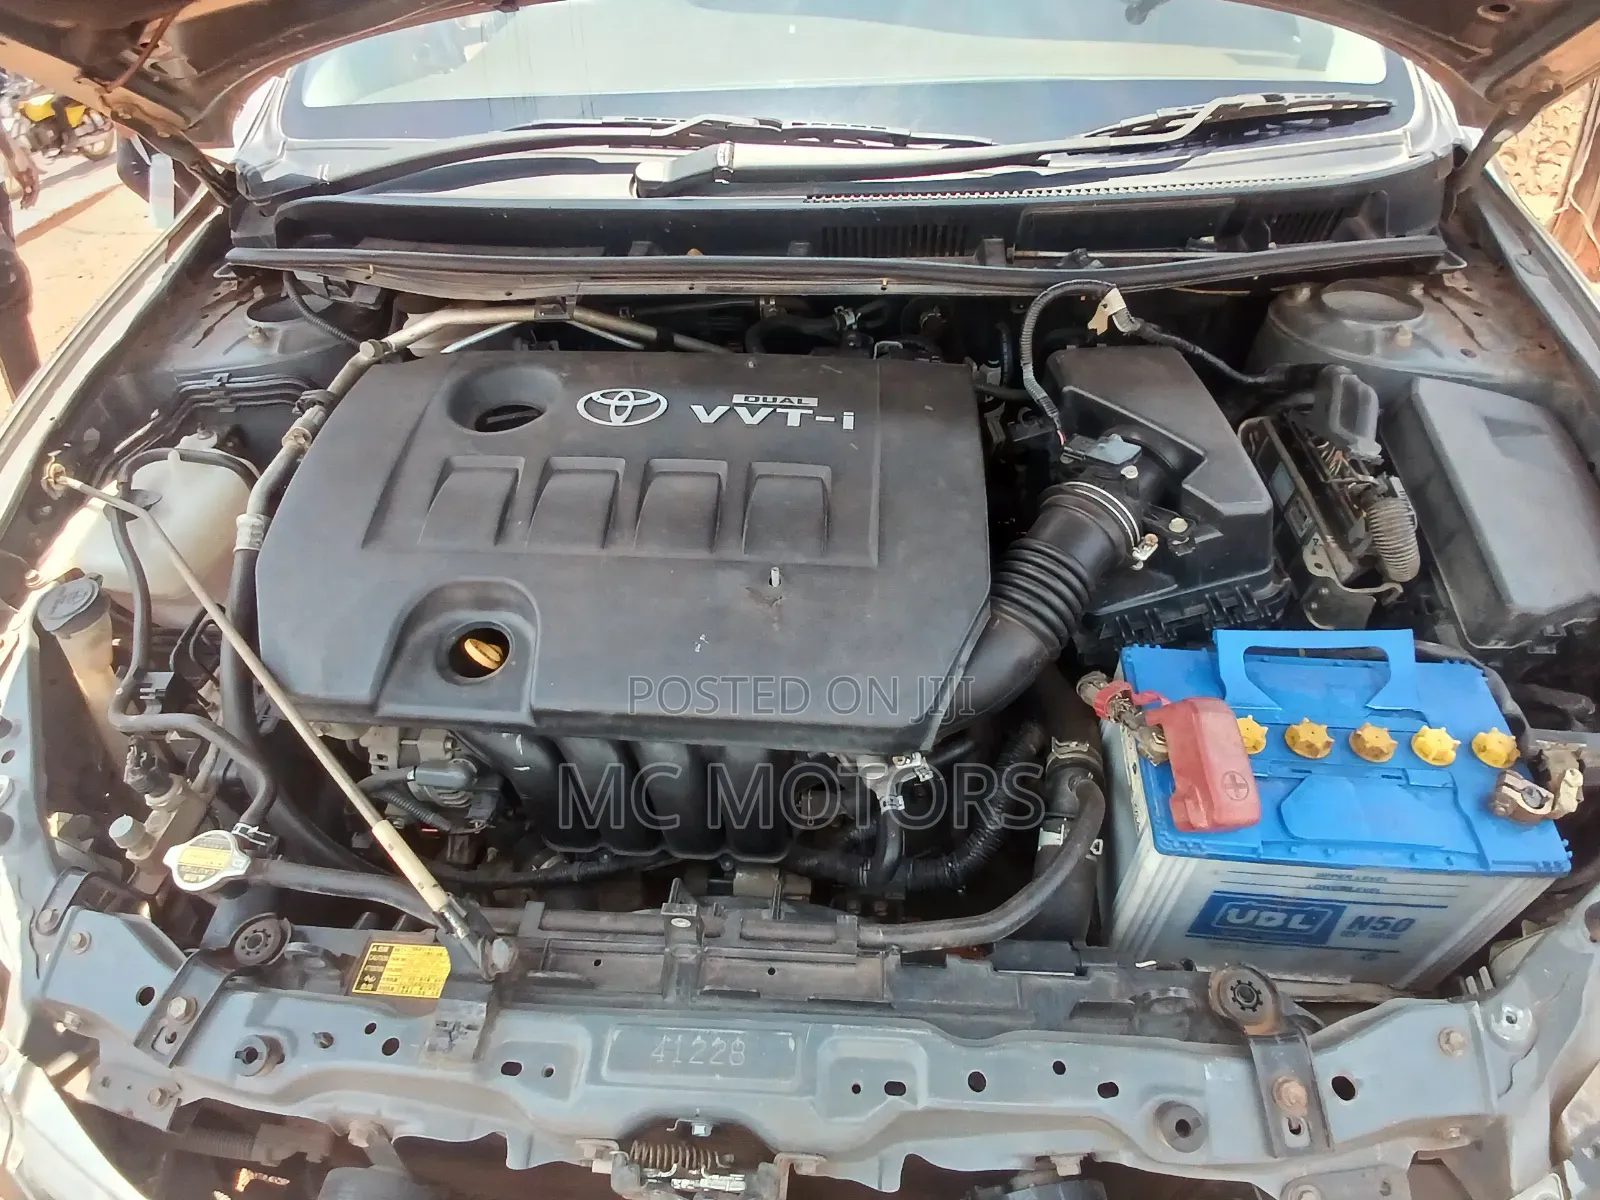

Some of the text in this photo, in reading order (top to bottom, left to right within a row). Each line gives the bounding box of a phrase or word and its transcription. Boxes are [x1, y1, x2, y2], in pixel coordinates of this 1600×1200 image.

[743, 395, 811, 405] DUAL
[690, 404, 854, 430] VVT-i
[1354, 875, 1389, 883] LEVEL
[1346, 915, 1417, 933] N50
[651, 1034, 746, 1067] 41228
